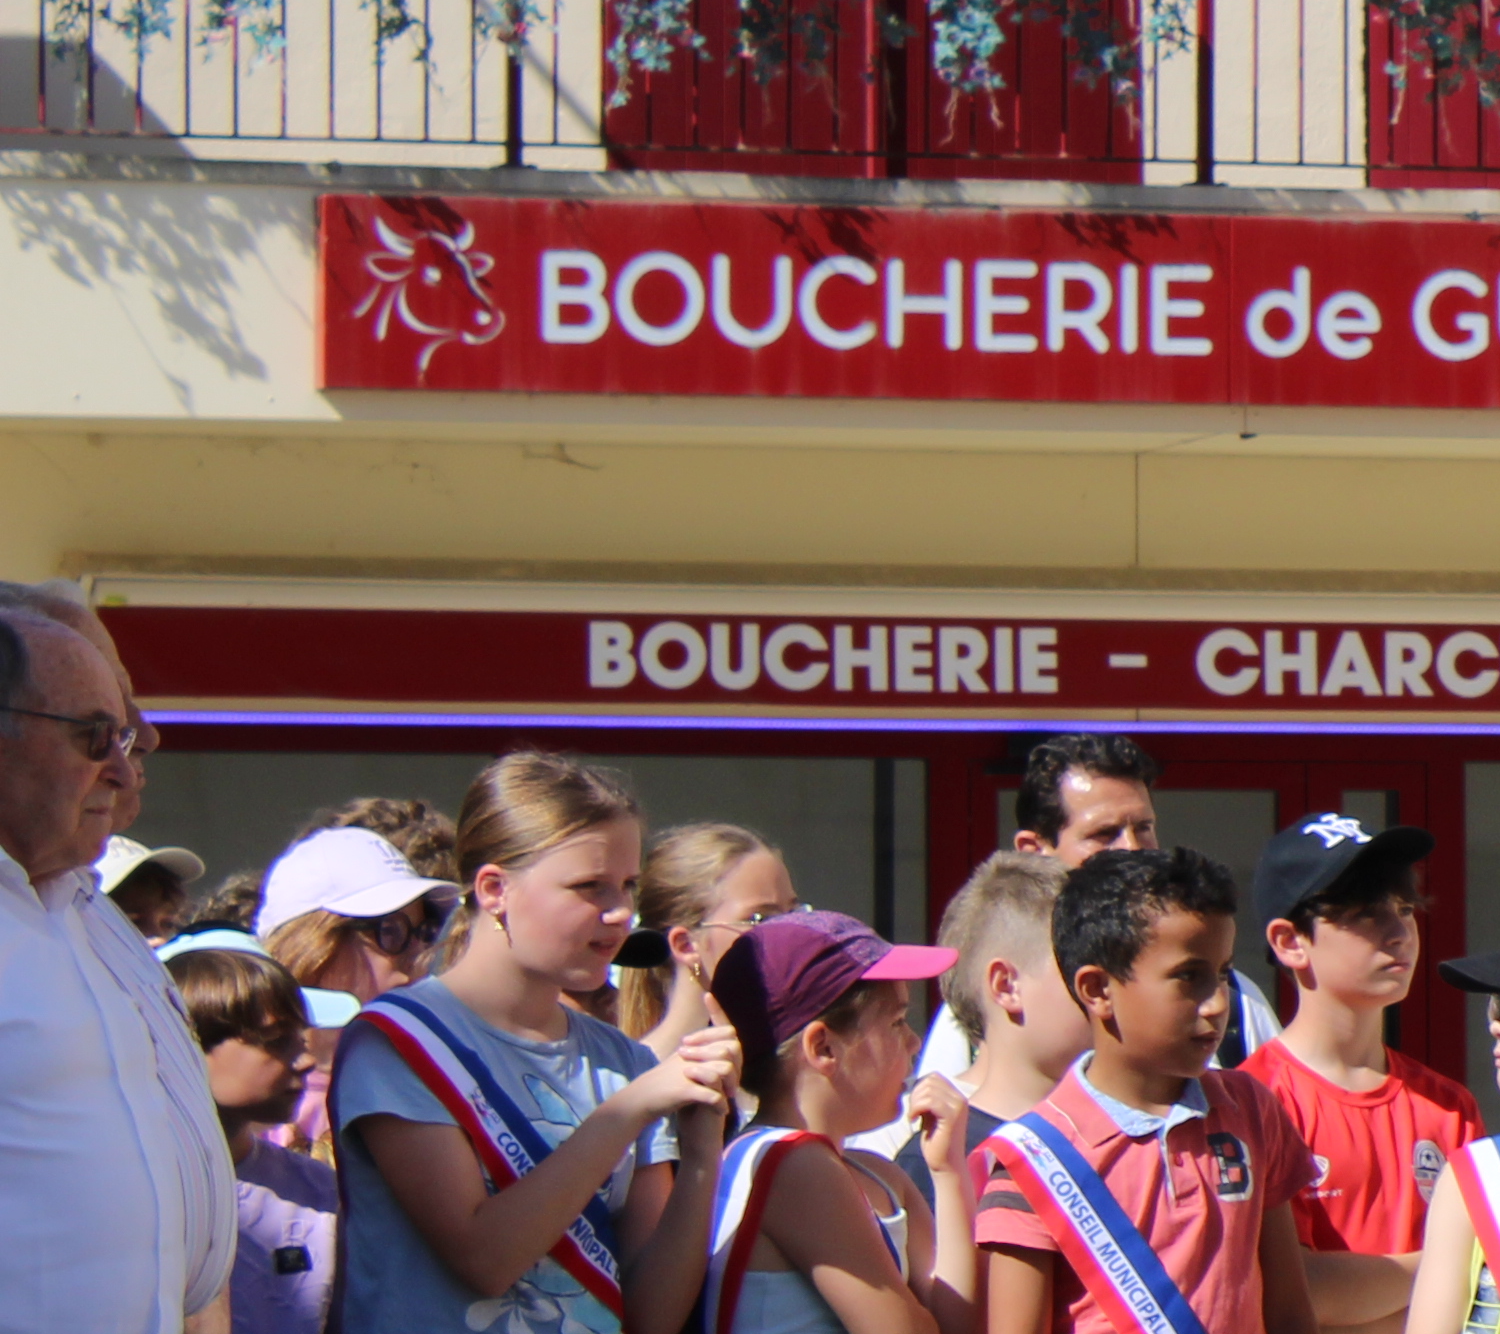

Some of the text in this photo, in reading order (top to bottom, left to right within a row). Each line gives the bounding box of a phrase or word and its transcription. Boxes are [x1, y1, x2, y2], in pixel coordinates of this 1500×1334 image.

[538, 248, 1213, 356] BOUCHERIE
[1244, 266, 1382, 361] de
[588, 621, 1059, 694] BOUCHERIE
[1206, 1131, 1255, 1203] B
[1048, 1170, 1104, 1245] CONSEIL
